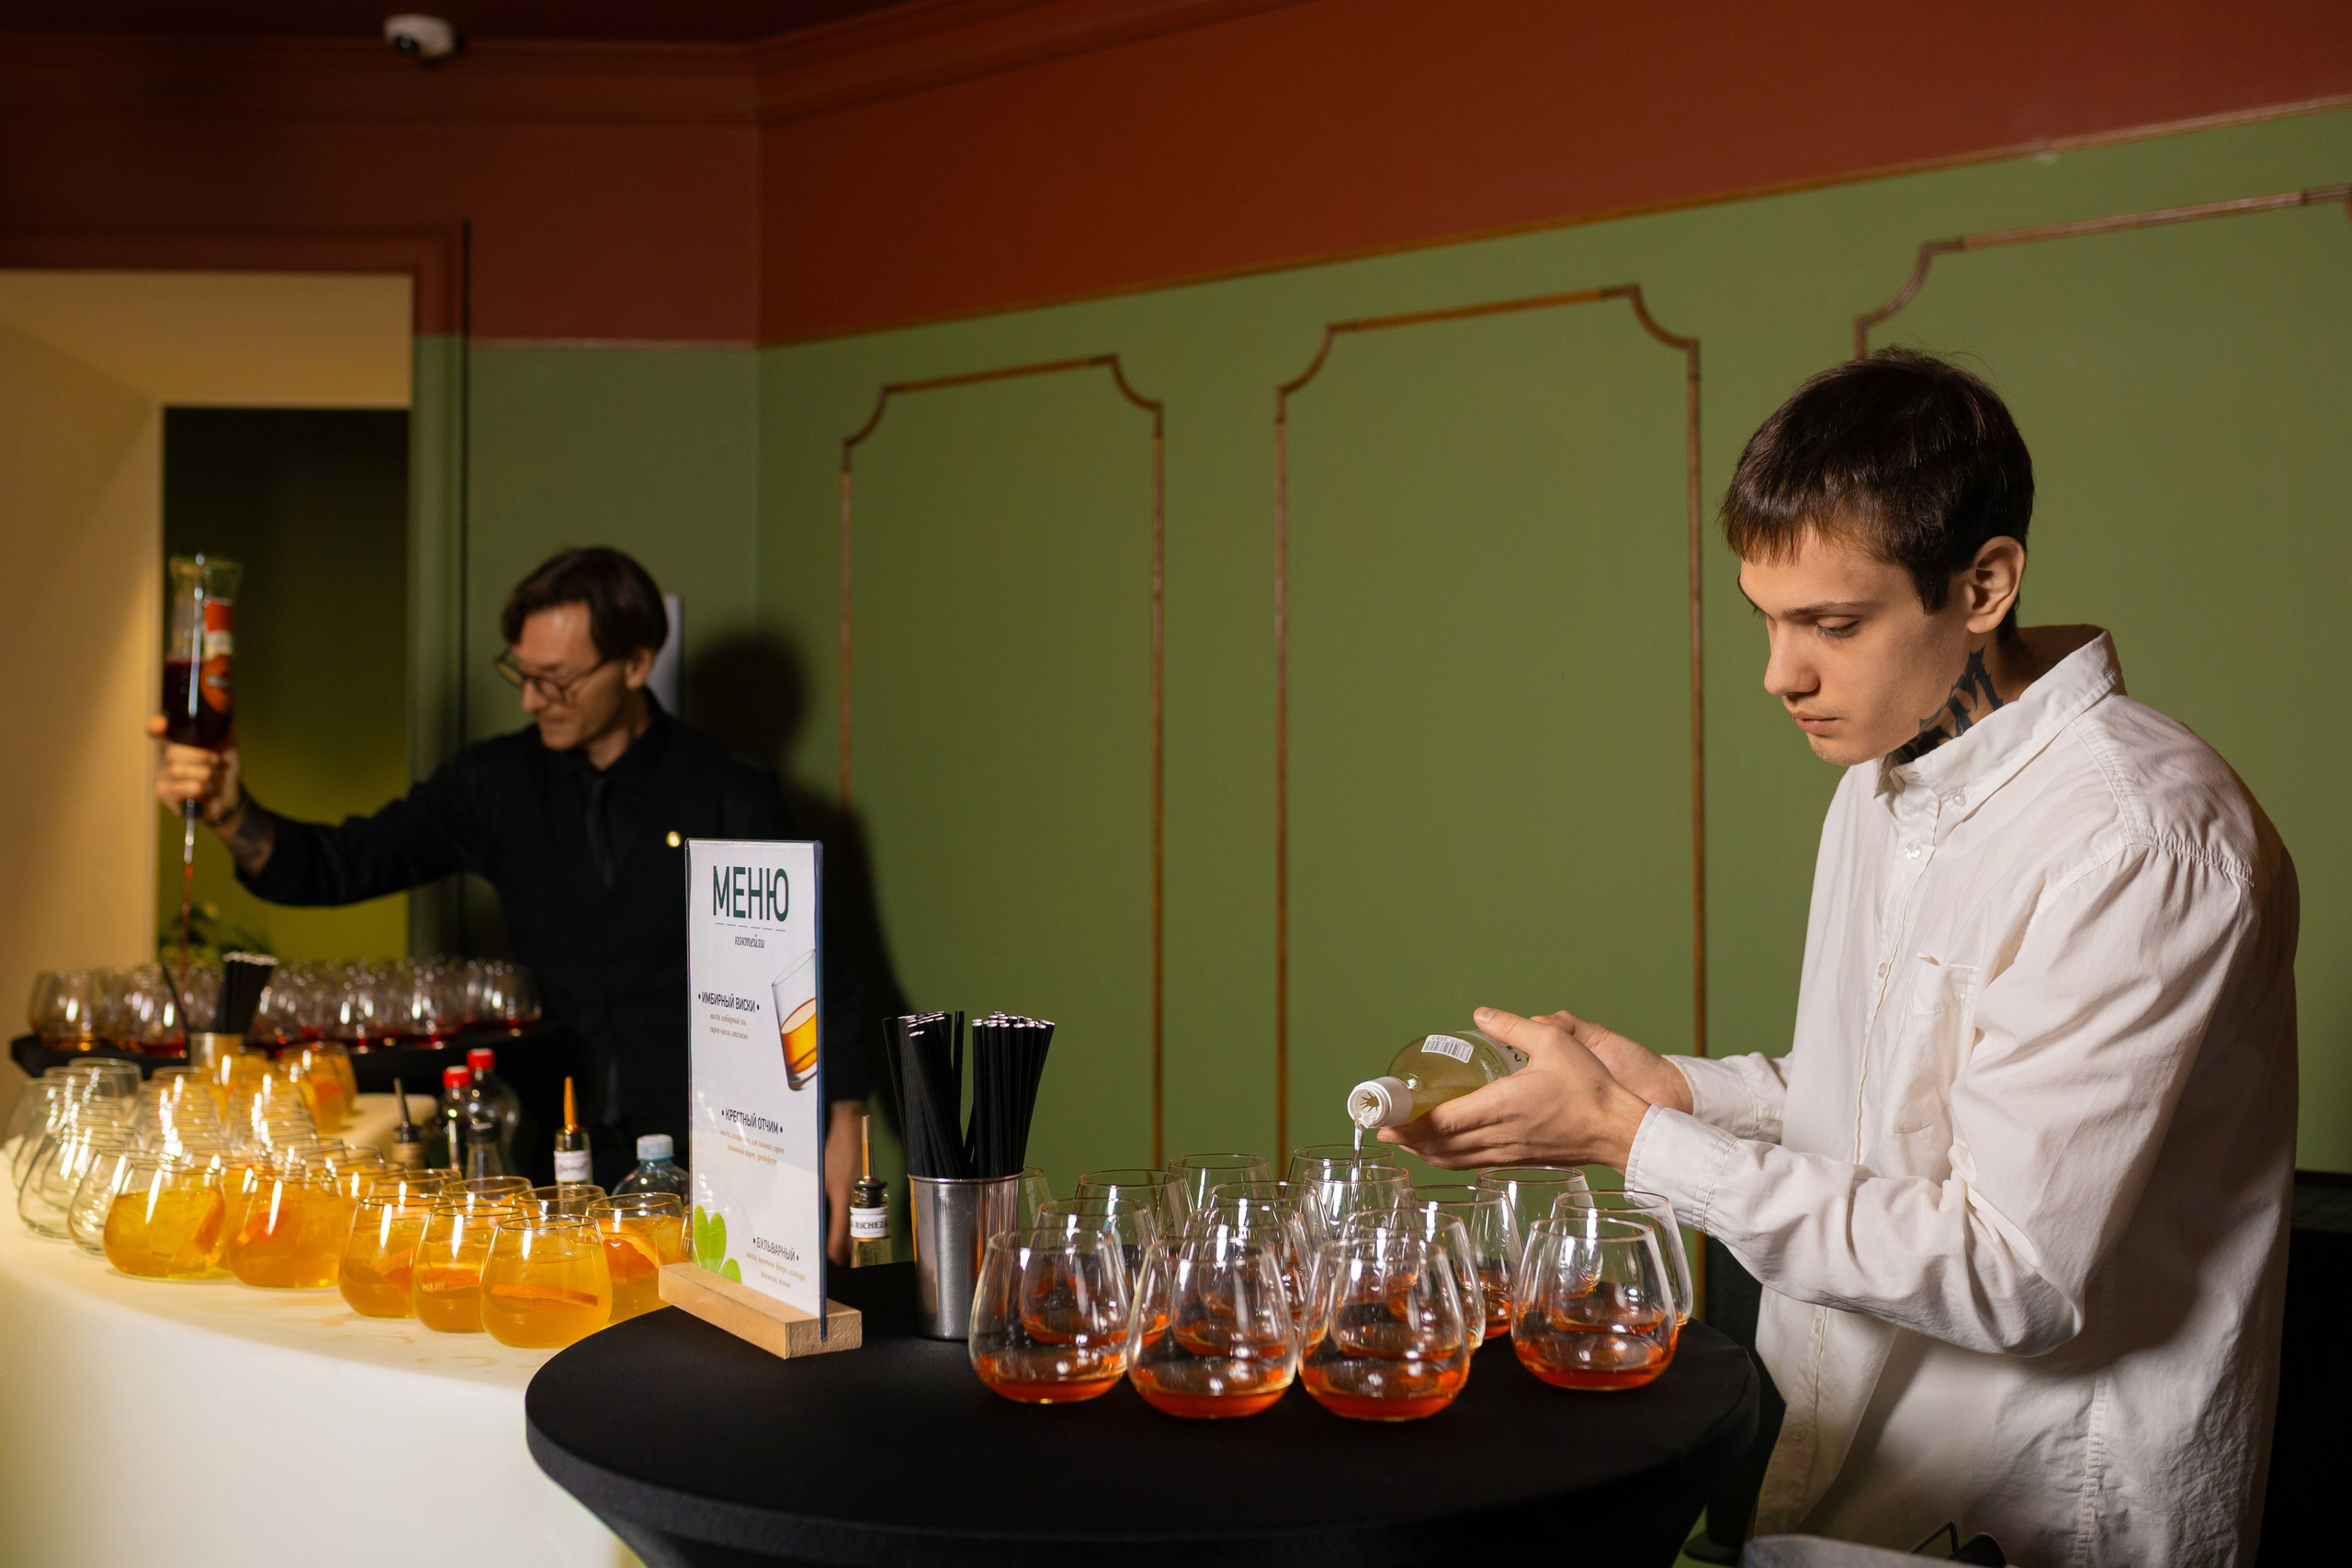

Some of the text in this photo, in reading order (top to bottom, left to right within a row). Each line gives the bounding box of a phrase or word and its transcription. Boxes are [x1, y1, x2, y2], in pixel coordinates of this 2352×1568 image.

[713, 865, 789, 922] МЕНЮ
[735, 934, 764, 949] коктейли
[702, 991, 755, 1012] ИМБИРНЫЙ ВИСКИ
[725, 1108, 778, 1134] КРЕСТНЫЙ ОТЧИМ
[756, 1236, 795, 1262] БУЛЬВАРНЫЙ
